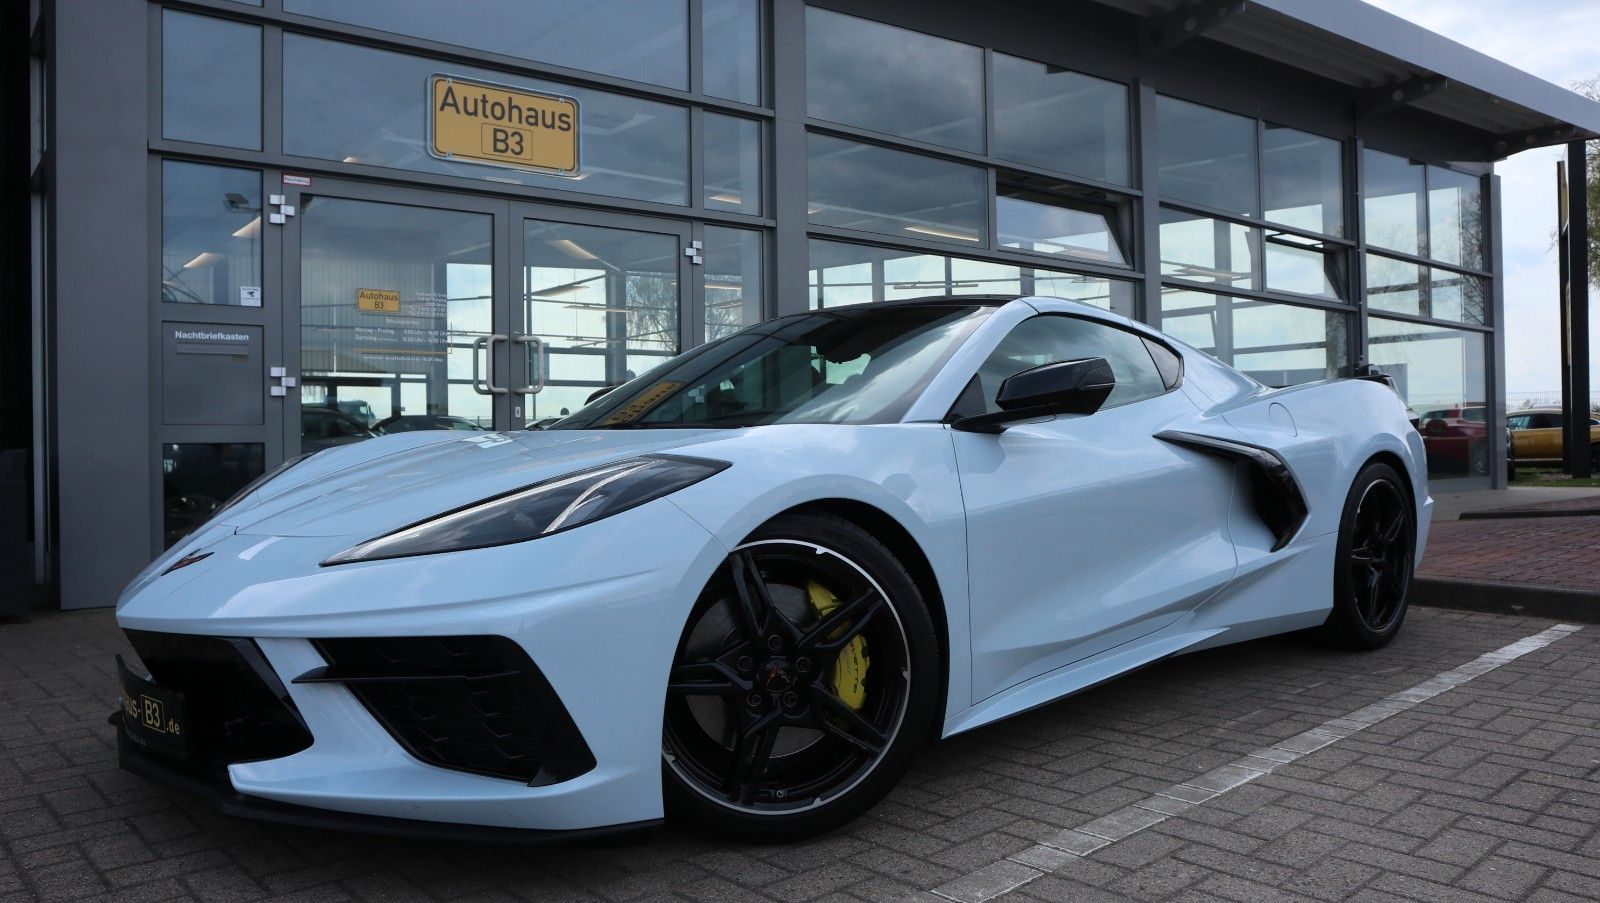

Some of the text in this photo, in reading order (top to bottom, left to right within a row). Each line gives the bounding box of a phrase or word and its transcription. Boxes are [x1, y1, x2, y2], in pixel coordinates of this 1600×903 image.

[439, 86, 572, 132] Autohaus
[492, 128, 524, 155] B3
[360, 290, 398, 301] Autohaus
[374, 301, 384, 309] B3
[175, 330, 249, 341] Nachtbriefkasten
